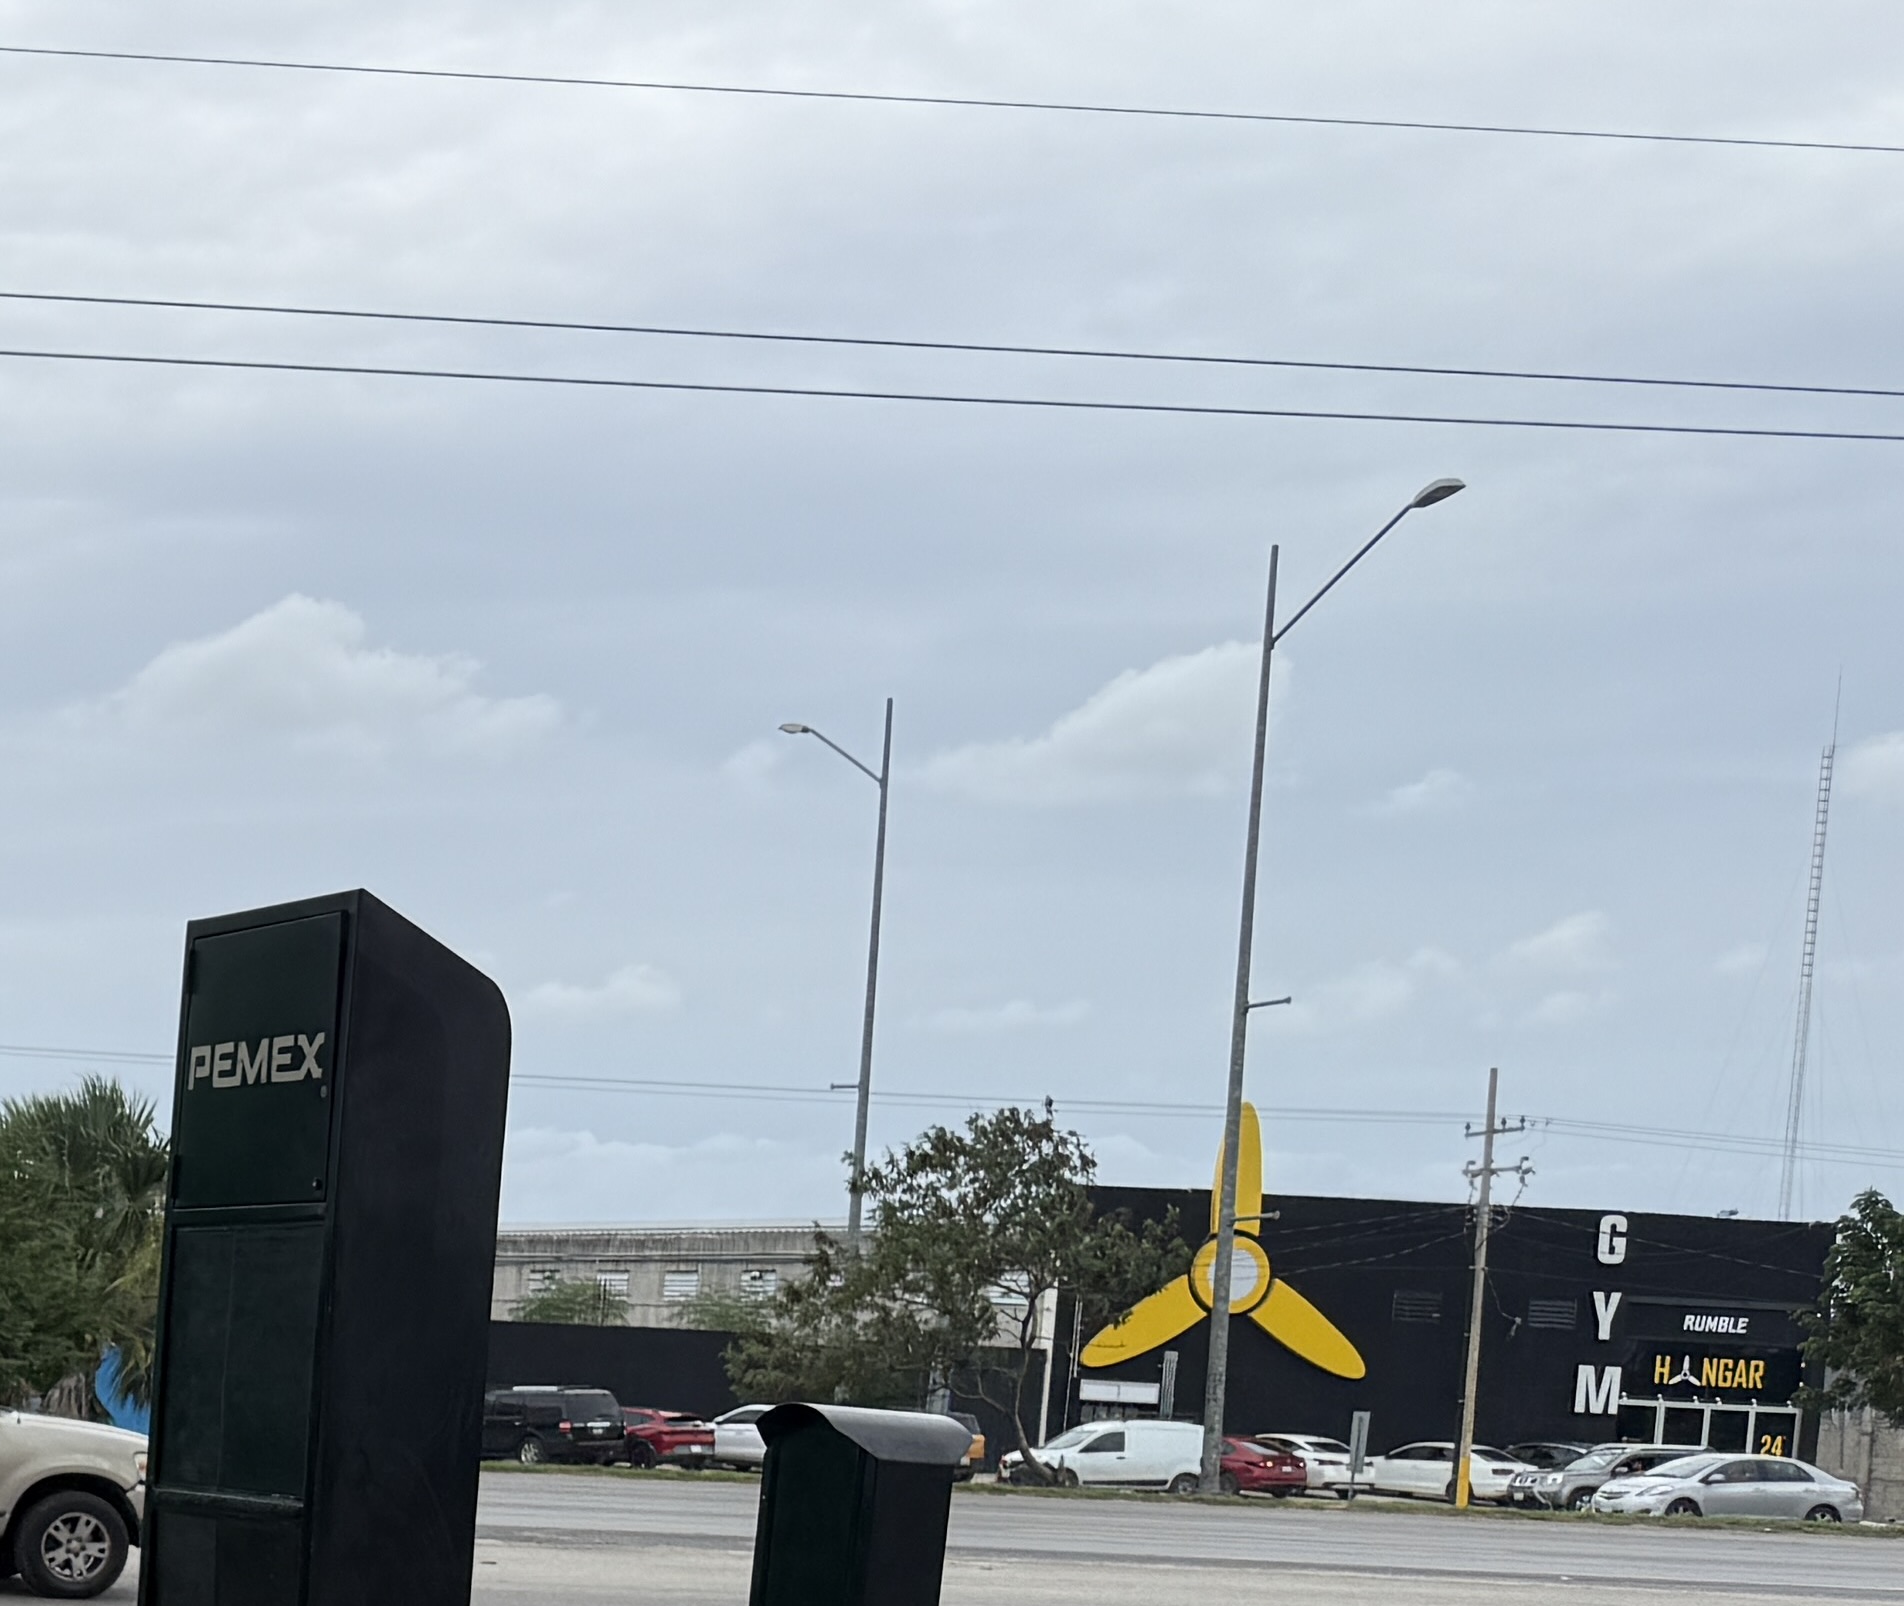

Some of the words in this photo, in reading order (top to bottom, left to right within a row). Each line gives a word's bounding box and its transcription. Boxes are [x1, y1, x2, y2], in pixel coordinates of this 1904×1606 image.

[187, 1031, 326, 1091] PEMEX
[1573, 1214, 1629, 1415] GYM
[1682, 1314, 1750, 1334] RUMBLE
